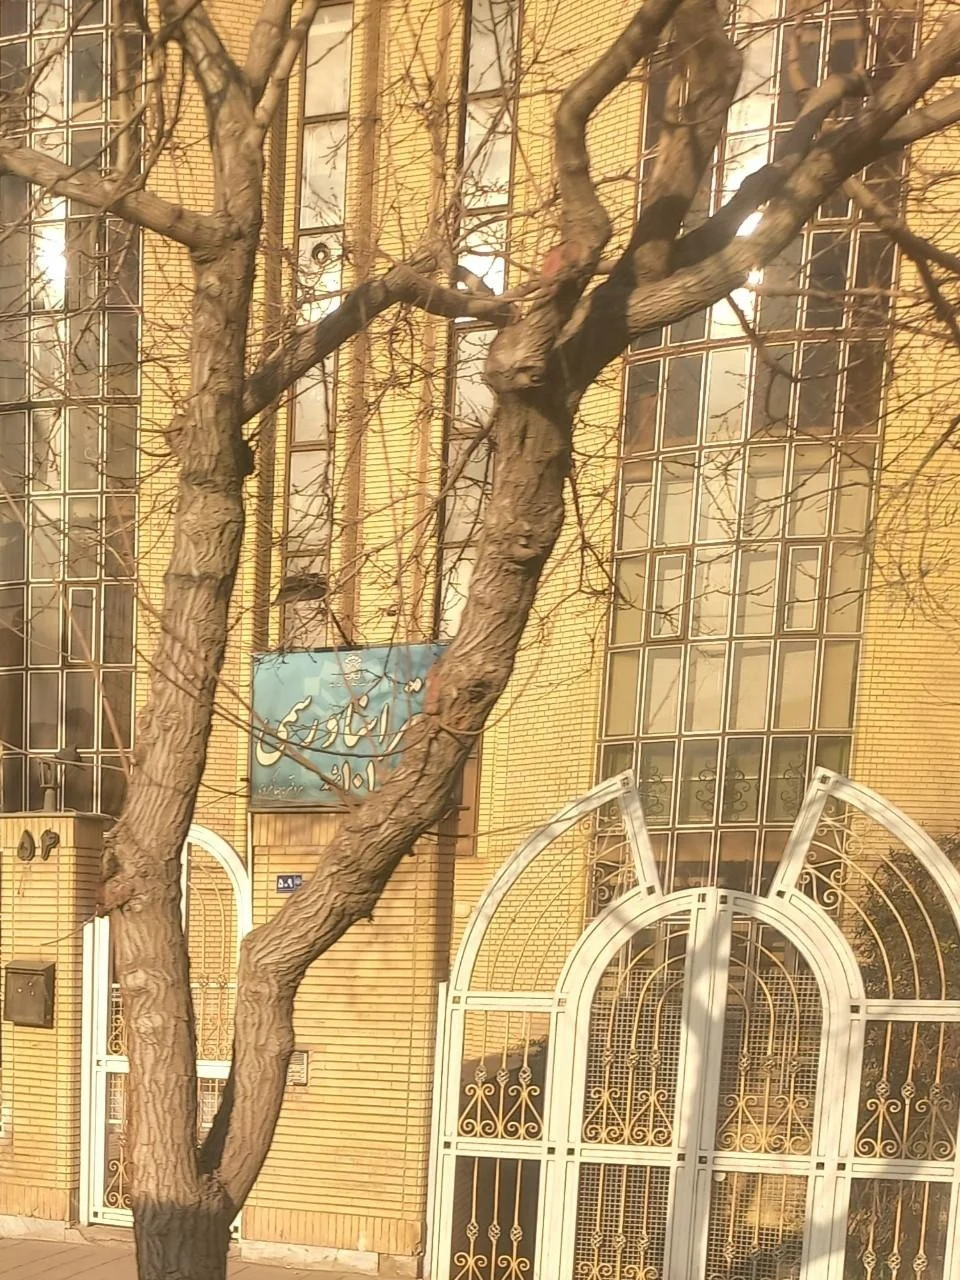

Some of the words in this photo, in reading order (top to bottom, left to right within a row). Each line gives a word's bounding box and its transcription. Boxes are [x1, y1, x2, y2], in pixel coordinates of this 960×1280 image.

[256, 694, 319, 766] رسمی
[341, 760, 376, 792] ۱۰۱
[277, 878, 294, 888] ۵۰۹
